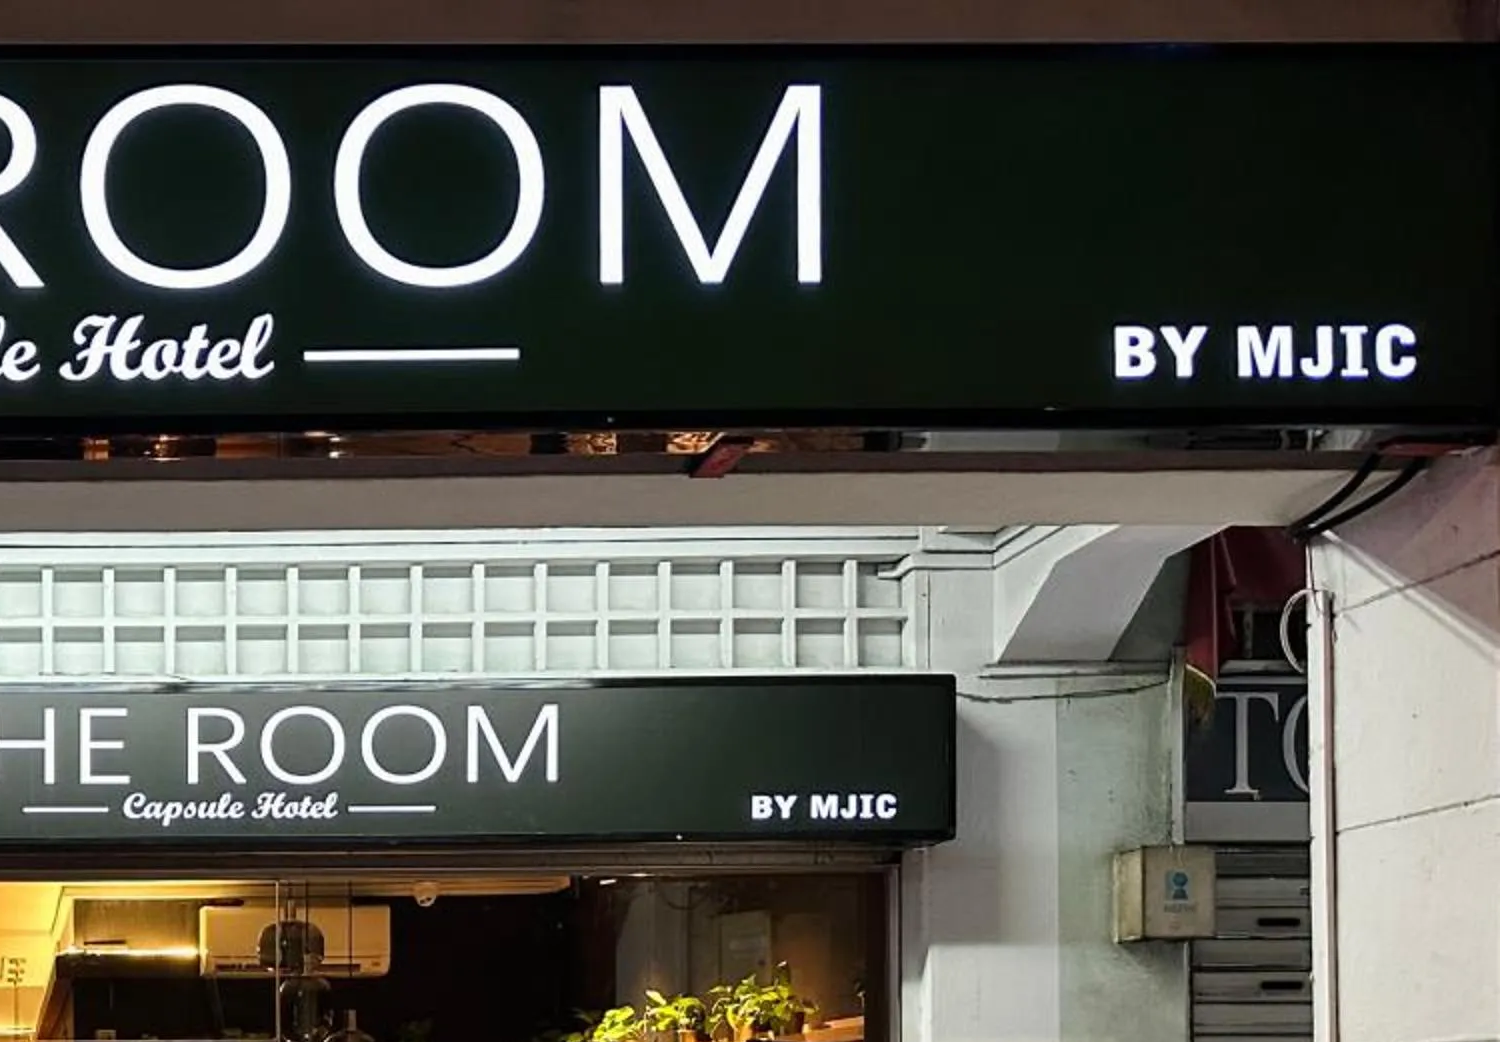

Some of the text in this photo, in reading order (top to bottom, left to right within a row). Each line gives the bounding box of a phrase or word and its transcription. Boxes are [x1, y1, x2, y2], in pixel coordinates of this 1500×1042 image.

[58, 312, 276, 383] Hotel
[1113, 323, 1418, 379] BY MJIC
[186, 703, 559, 785] ROOM
[121, 790, 340, 828] Capsule Hotel
[750, 792, 898, 821] BY MJIC
